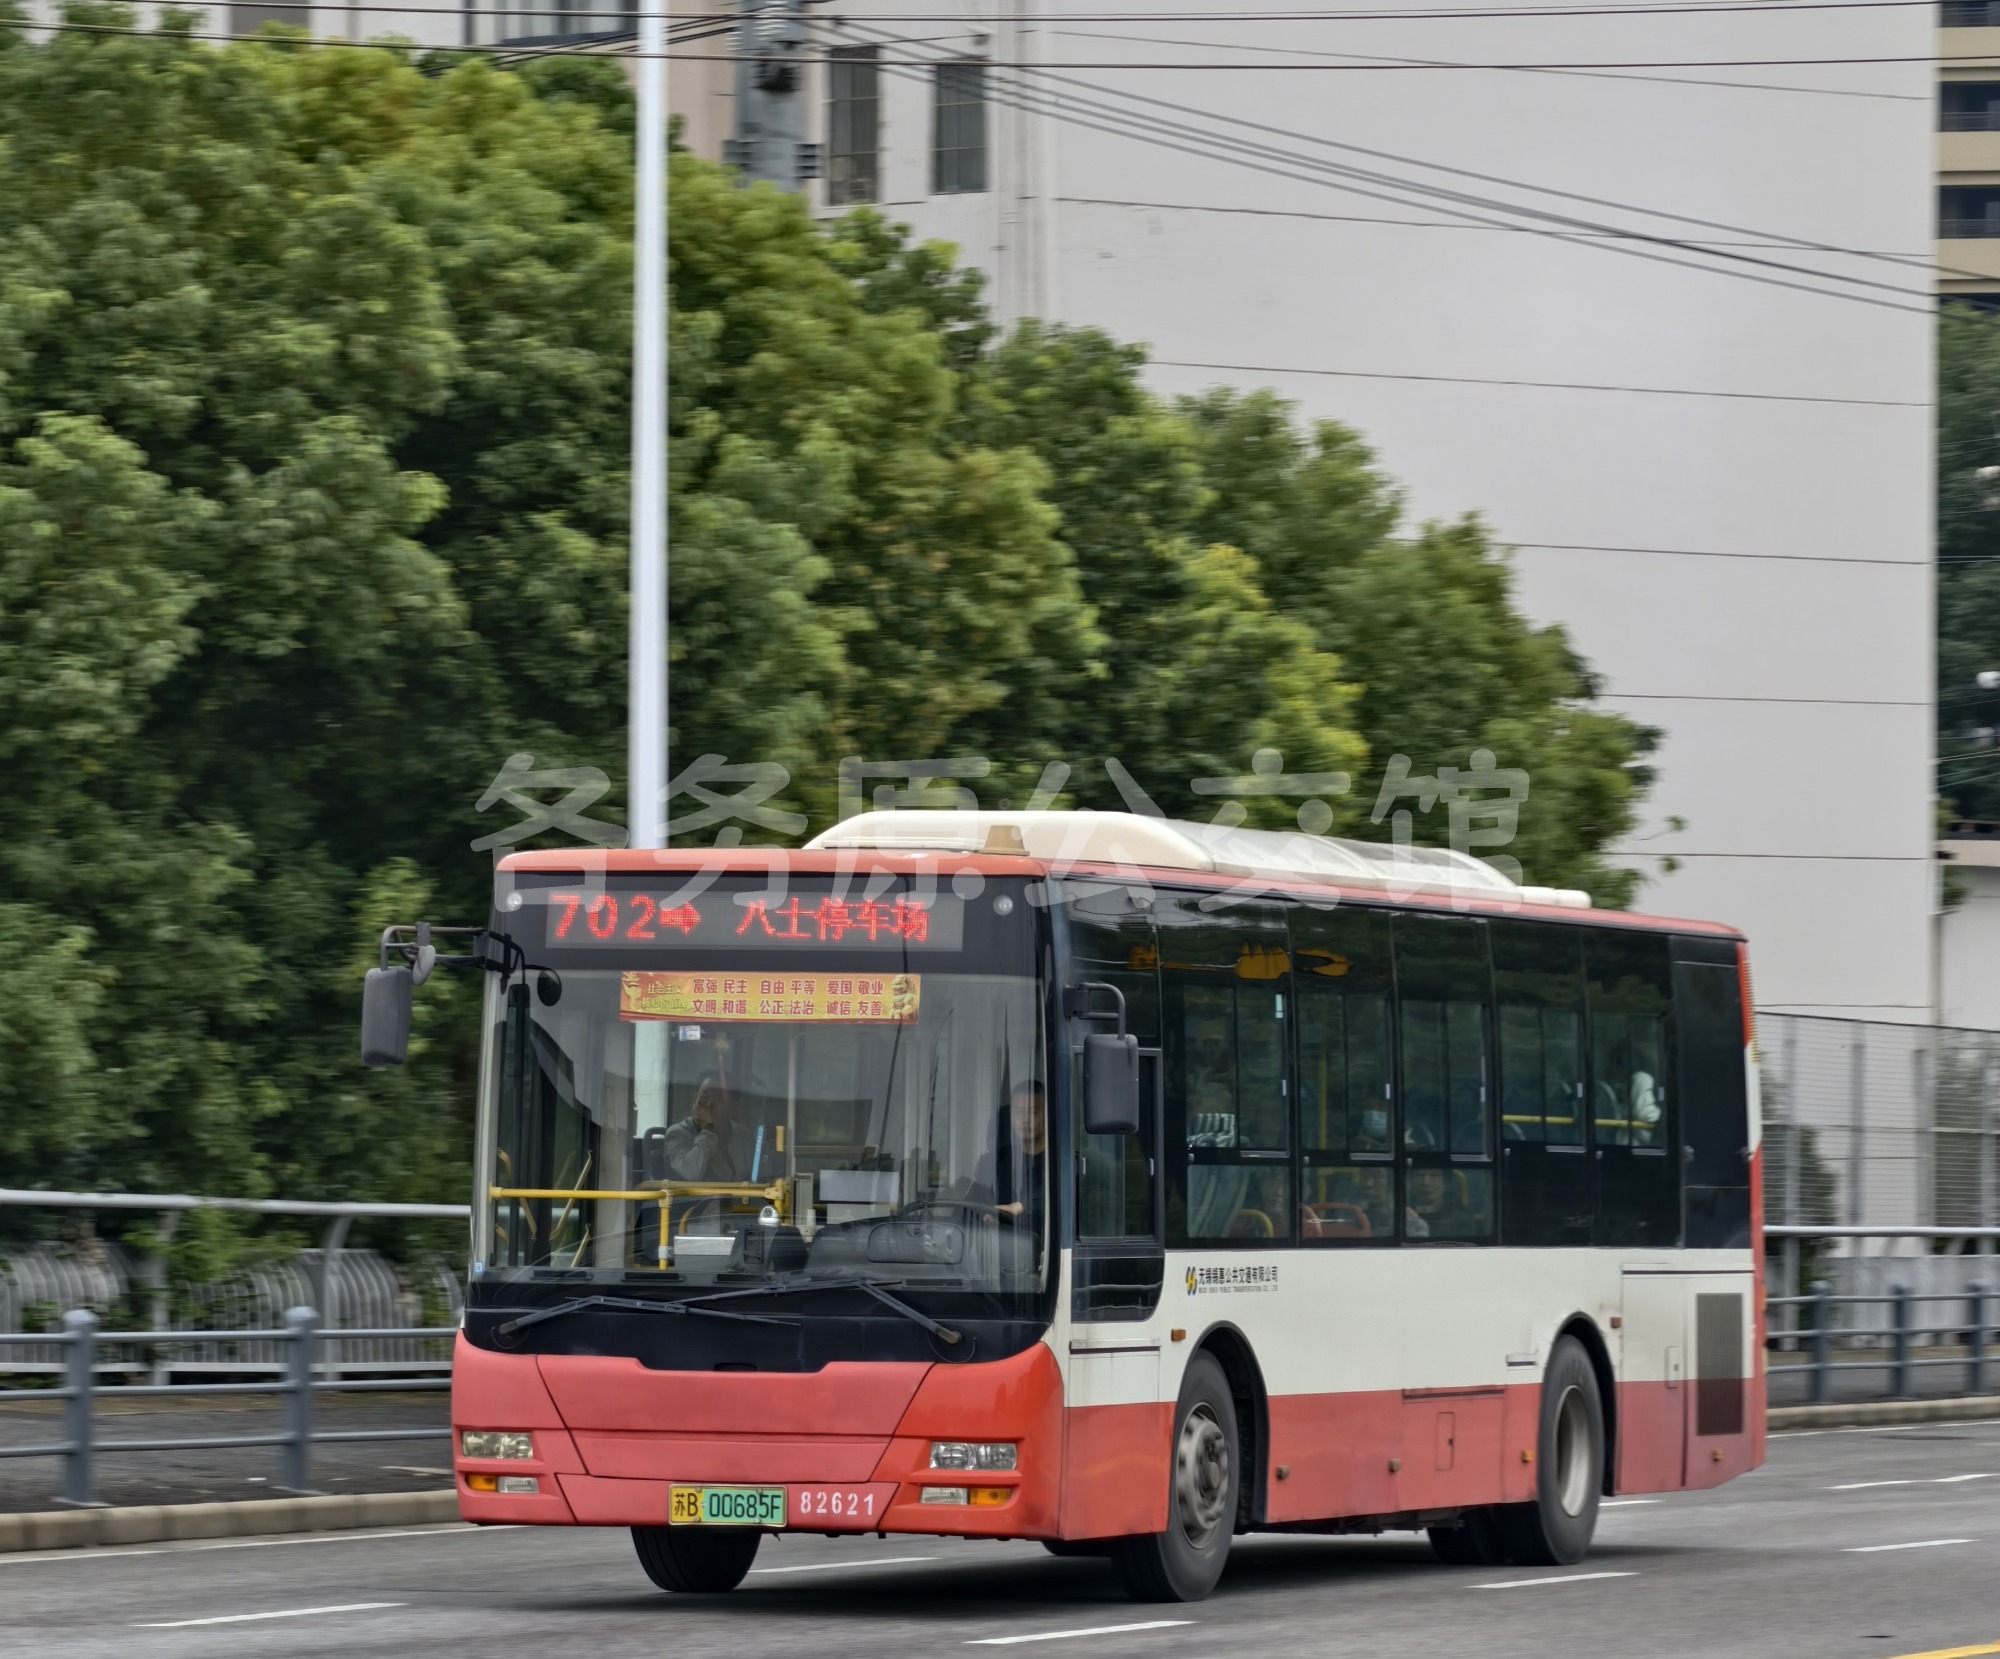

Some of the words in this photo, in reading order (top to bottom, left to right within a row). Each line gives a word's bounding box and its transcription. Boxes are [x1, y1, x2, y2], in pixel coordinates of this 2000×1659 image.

[552, 894, 656, 939] 702
[735, 898, 929, 941] 八士停车场
[693, 979, 718, 994] 富强
[723, 979, 748, 994] 民主
[760, 979, 785, 995] 自由
[790, 979, 816, 995] 平等
[827, 980, 852, 995] 爱国
[858, 980, 883, 995] 敬业
[692, 999, 717, 1014] 文明
[722, 999, 747, 1015] 和谐
[759, 1000, 784, 1015] 公正
[789, 1000, 815, 1015] 法治
[826, 1000, 851, 1016] 诚信
[857, 1000, 883, 1016] 友善
[1199, 1266, 1278, 1284] 无锡锡惠公共交通有限公司
[709, 1492, 782, 1519] 00685F
[800, 1491, 874, 1516] 82621
